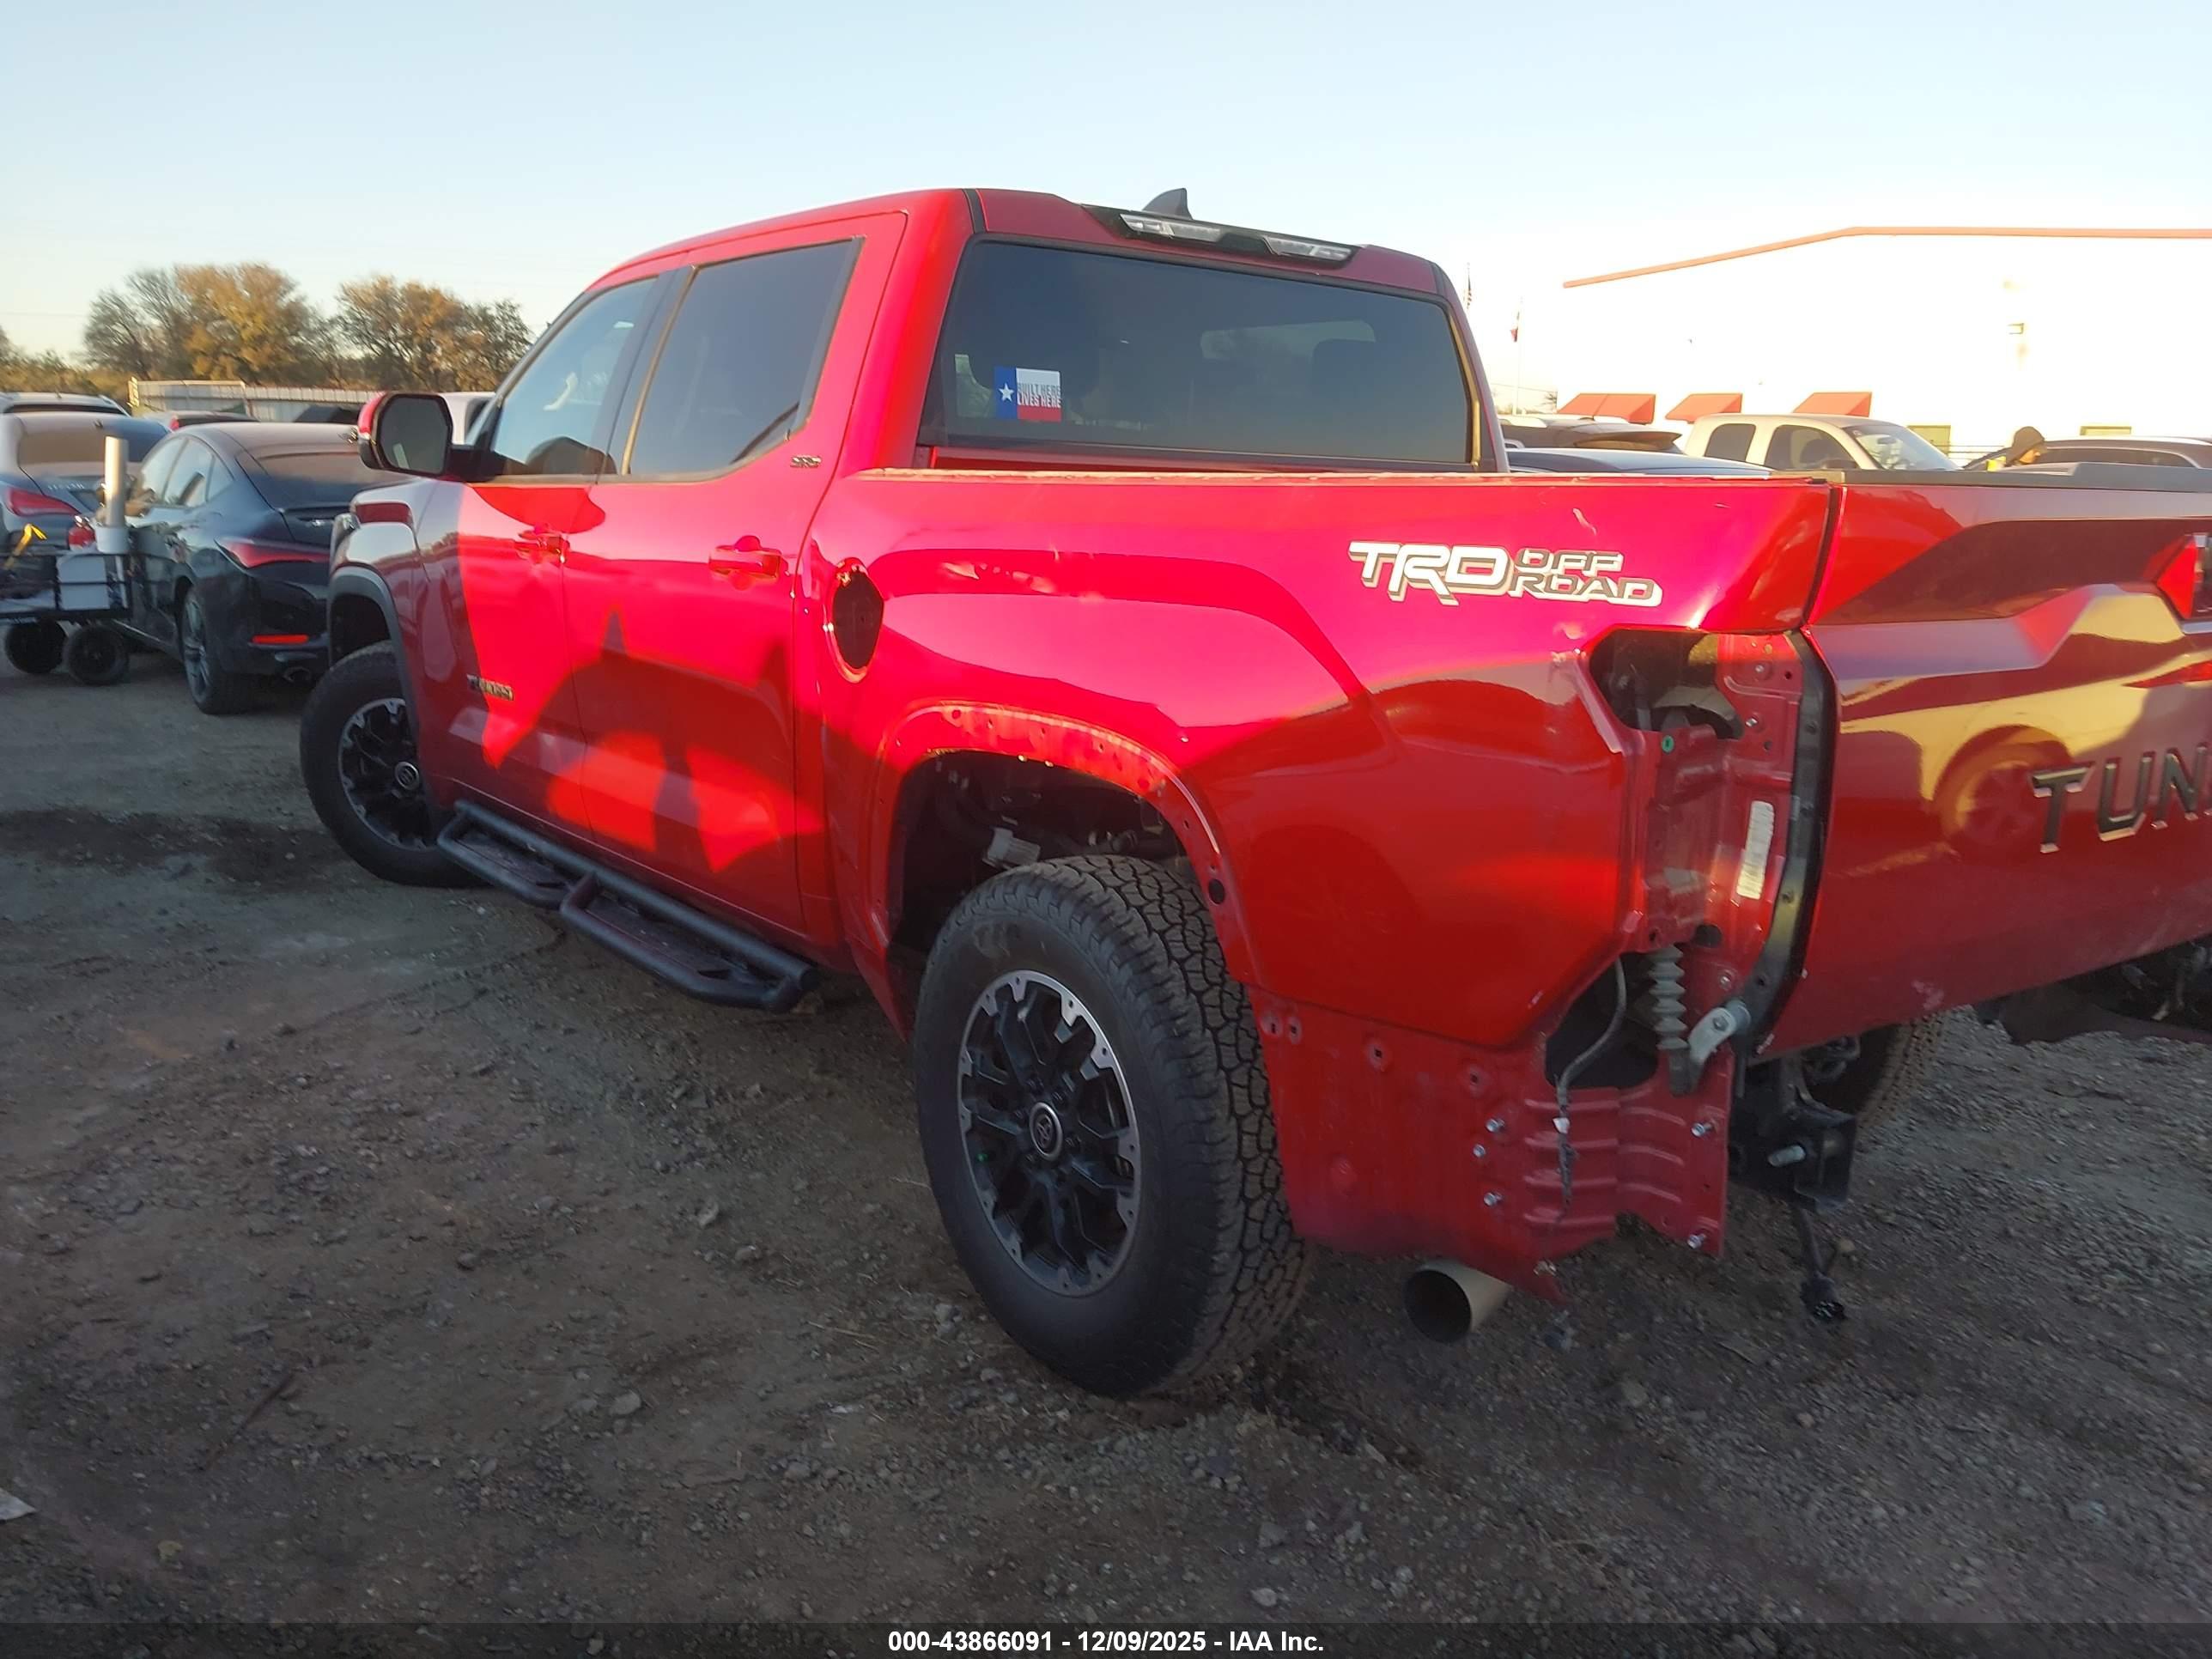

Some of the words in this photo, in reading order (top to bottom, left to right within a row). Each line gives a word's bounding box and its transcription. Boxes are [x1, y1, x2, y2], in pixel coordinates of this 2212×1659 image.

[1017, 392, 1040, 407] LIVES
[1040, 394, 1061, 408] HERE
[1018, 383, 1040, 395] BUILT
[1040, 385, 1060, 399] HERE
[1347, 541, 1516, 606] TRD
[1514, 548, 1625, 576] OFF
[1507, 573, 1663, 606] ROAD
[2032, 744, 2212, 854] TUN
